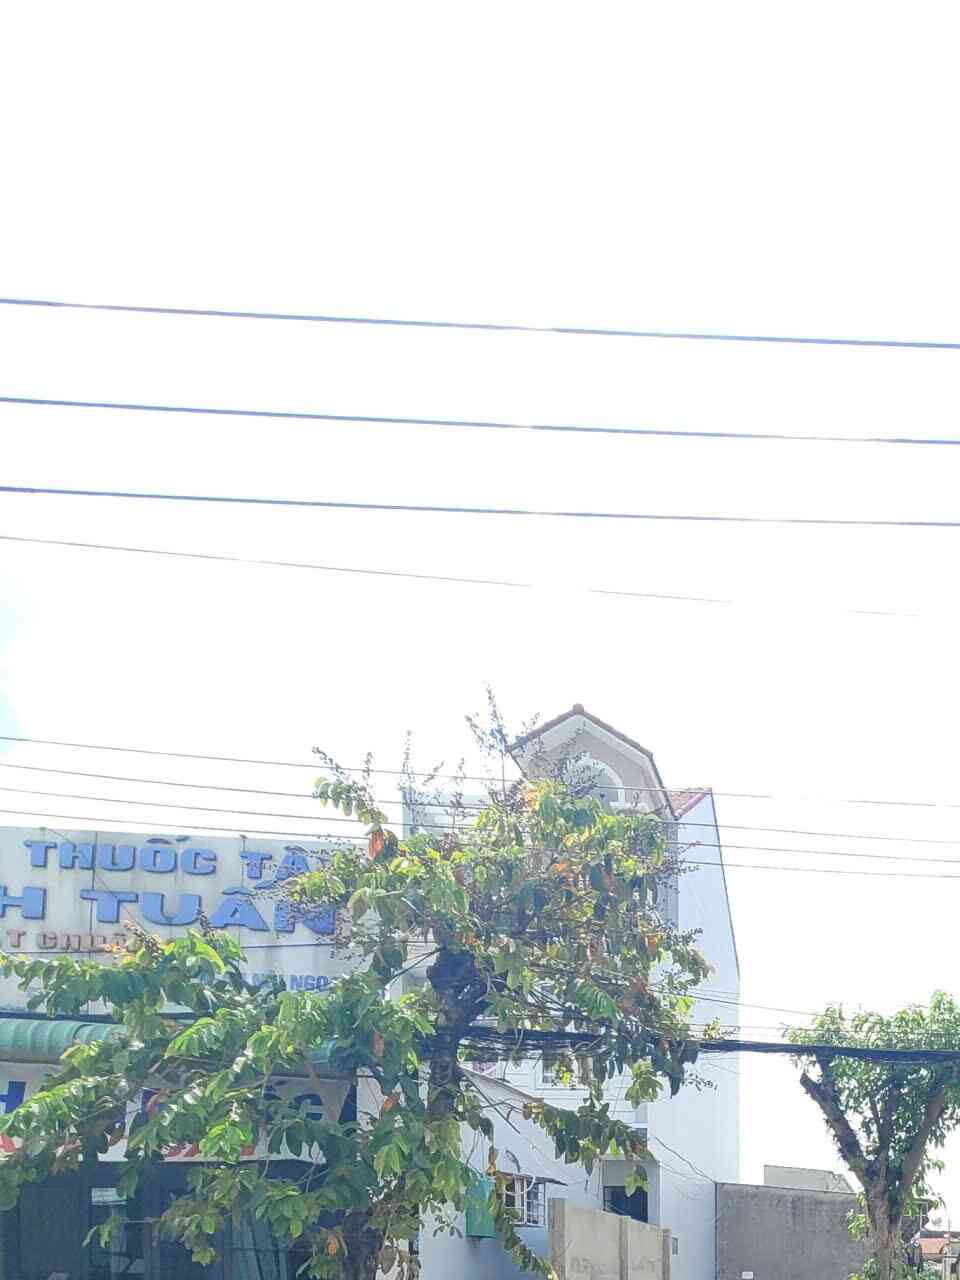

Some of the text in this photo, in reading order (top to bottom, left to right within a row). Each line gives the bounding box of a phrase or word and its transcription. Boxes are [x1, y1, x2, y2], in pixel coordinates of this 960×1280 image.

[23, 834, 316, 881] THUỐC TÂ
[79, 879, 337, 935] TUẤN
